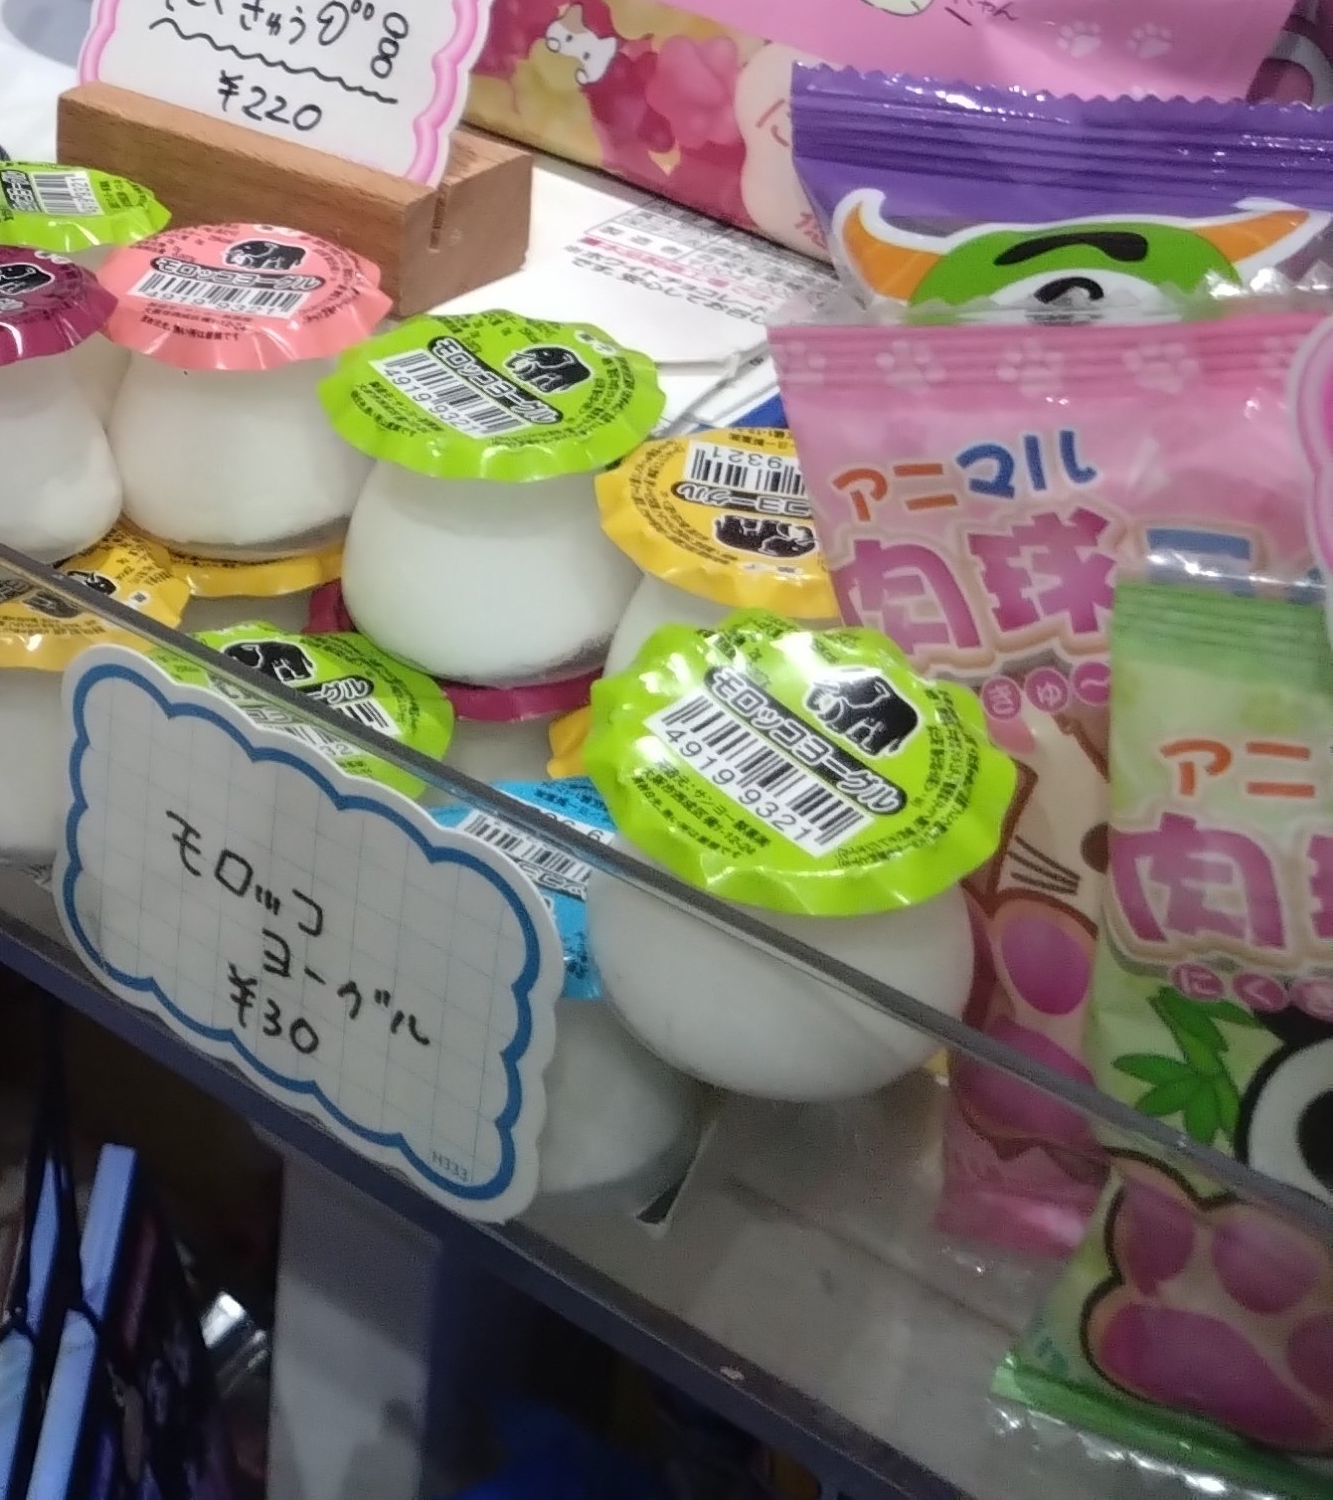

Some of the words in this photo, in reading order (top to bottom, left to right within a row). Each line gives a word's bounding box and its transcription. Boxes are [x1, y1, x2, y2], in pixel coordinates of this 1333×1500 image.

[216, 70, 324, 133] ¥220
[155, 256, 322, 291] モロッコヨーグル
[430, 337, 562, 424] モロッコヨーグル
[832, 428, 1099, 523] アニマル
[835, 506, 1118, 657] 肉球
[664, 725, 737, 787] 4919
[737, 786, 813, 844] 9321
[706, 665, 904, 817] モロッコヨーグル
[165, 807, 325, 938] モロッコ
[226, 963, 321, 1056] ¥30
[259, 928, 432, 1048] ヨーグル
